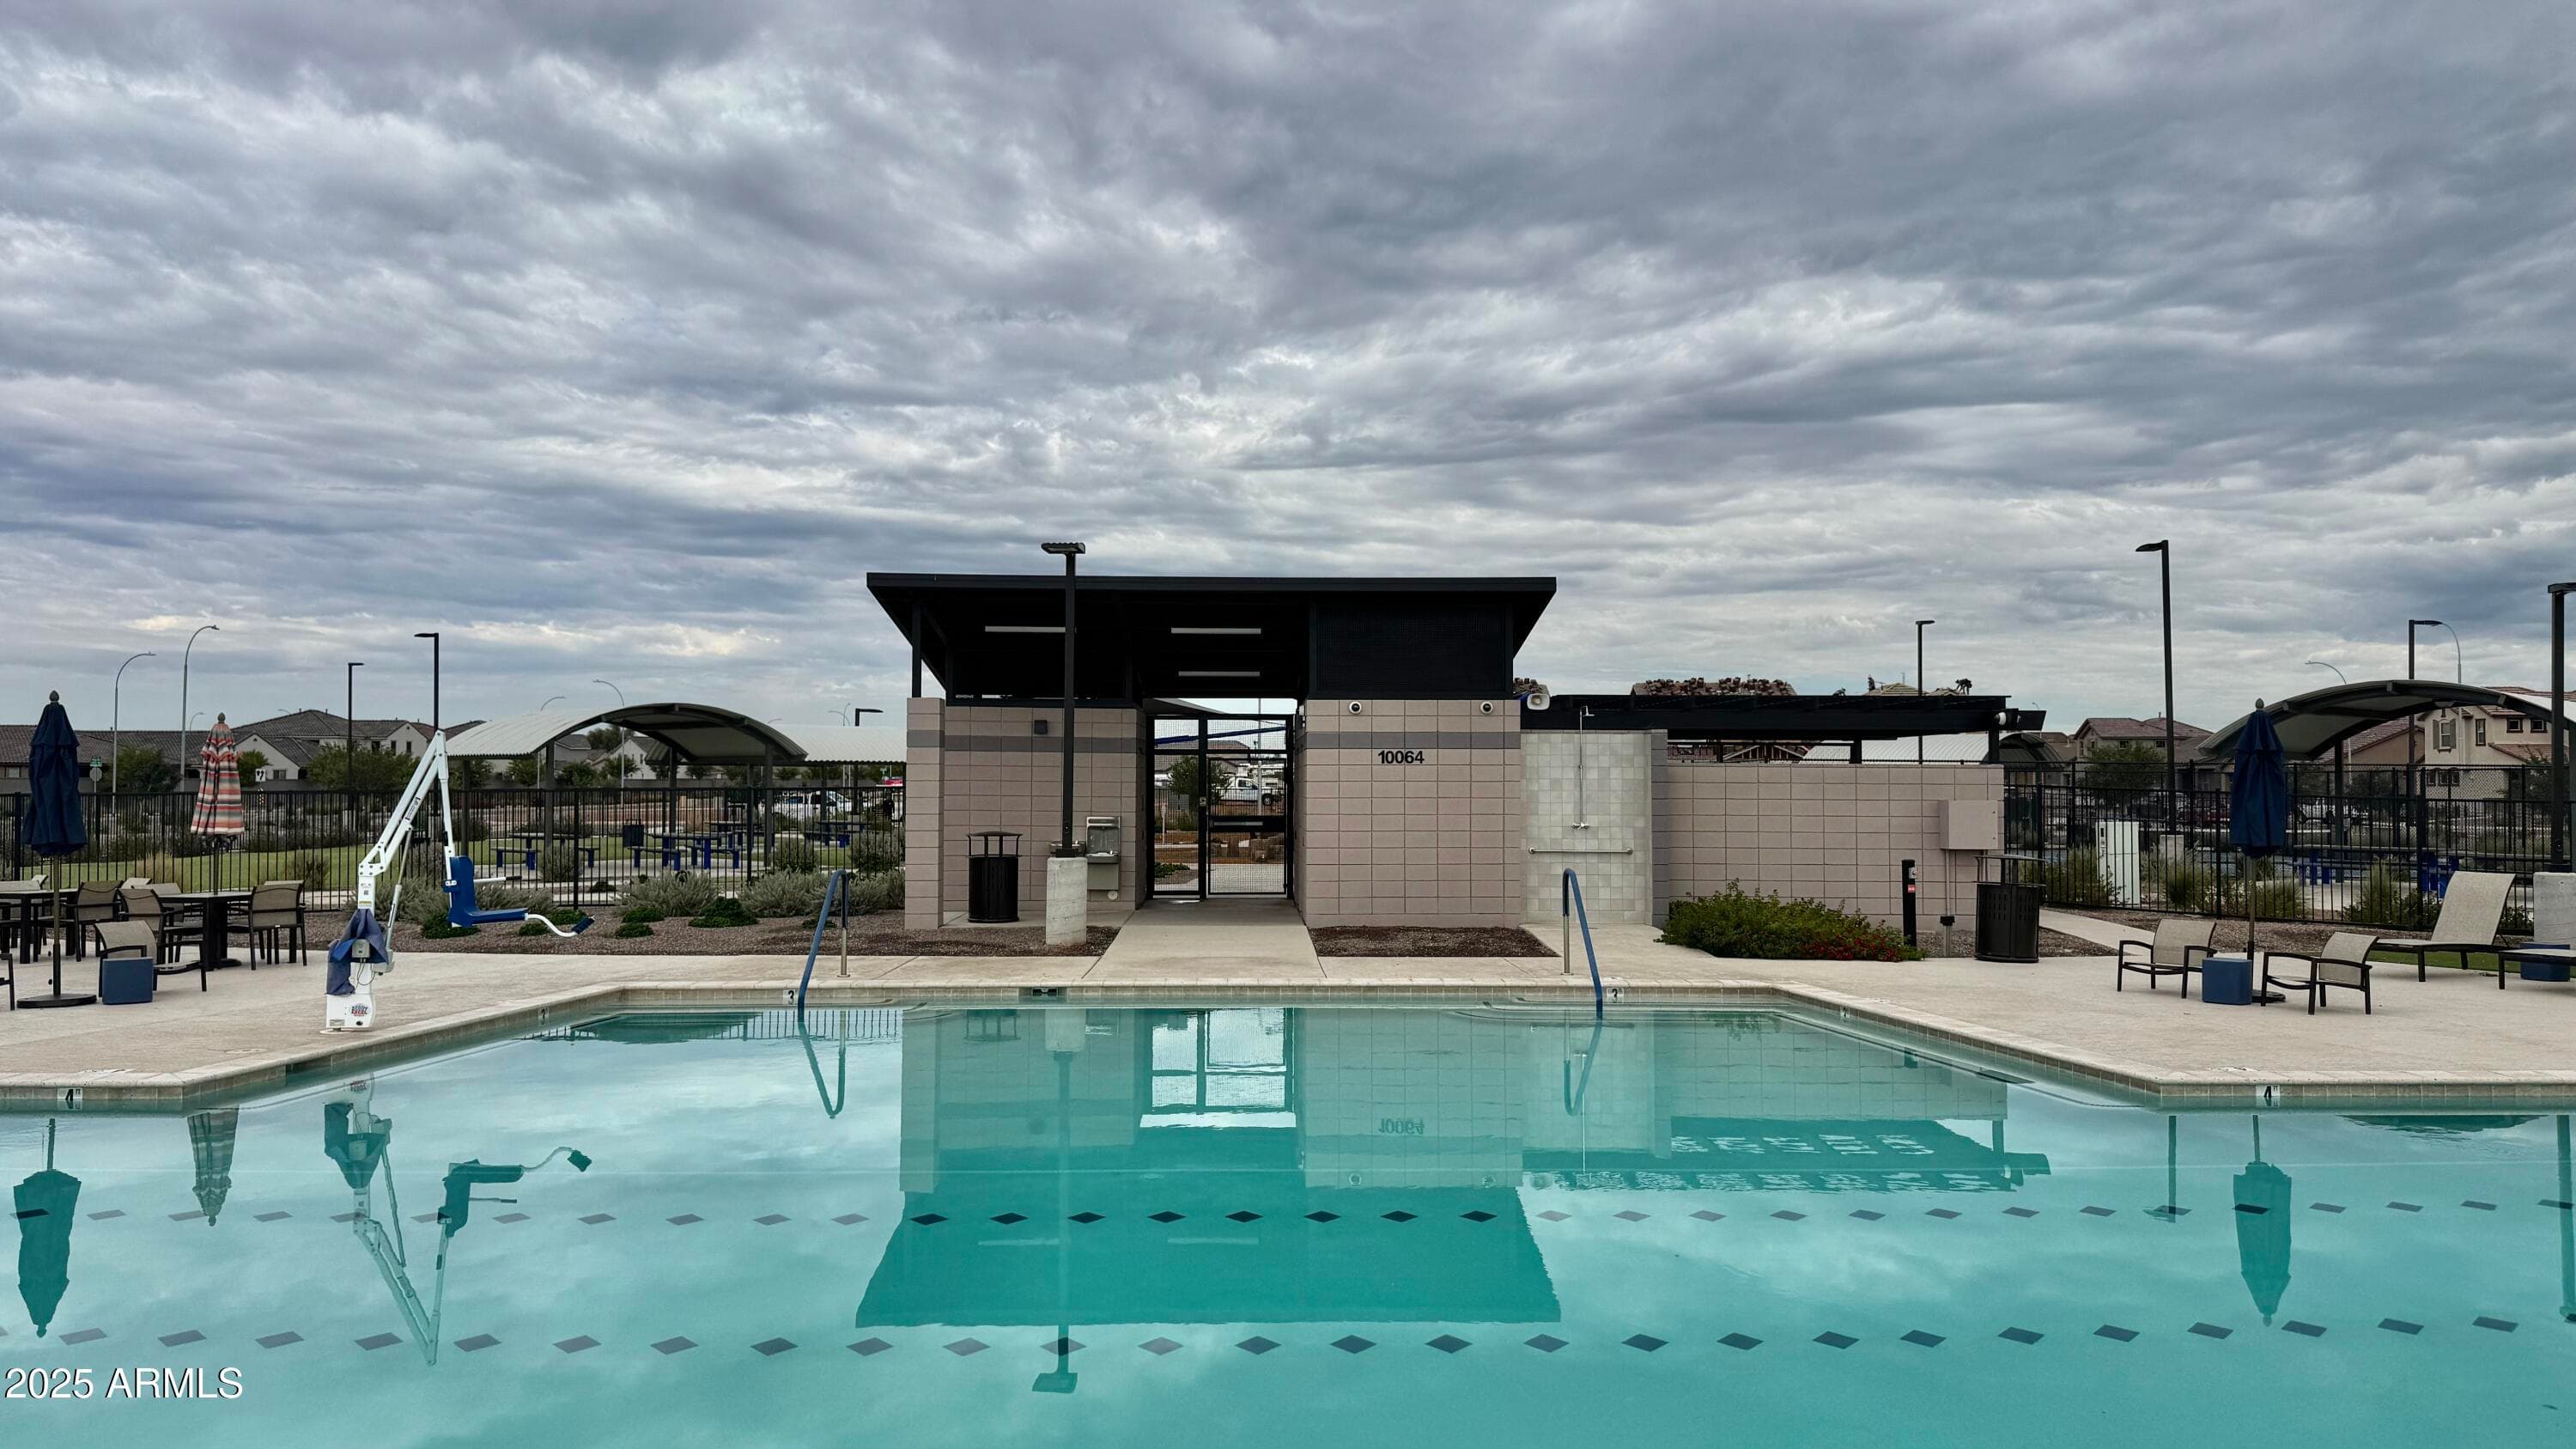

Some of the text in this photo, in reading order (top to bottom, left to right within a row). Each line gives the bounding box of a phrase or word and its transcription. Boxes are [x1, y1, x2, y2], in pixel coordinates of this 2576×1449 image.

[1378, 750, 1425, 764] 10064
[65, 1088, 74, 1100] 4
[2263, 1086, 2272, 1098] 4
